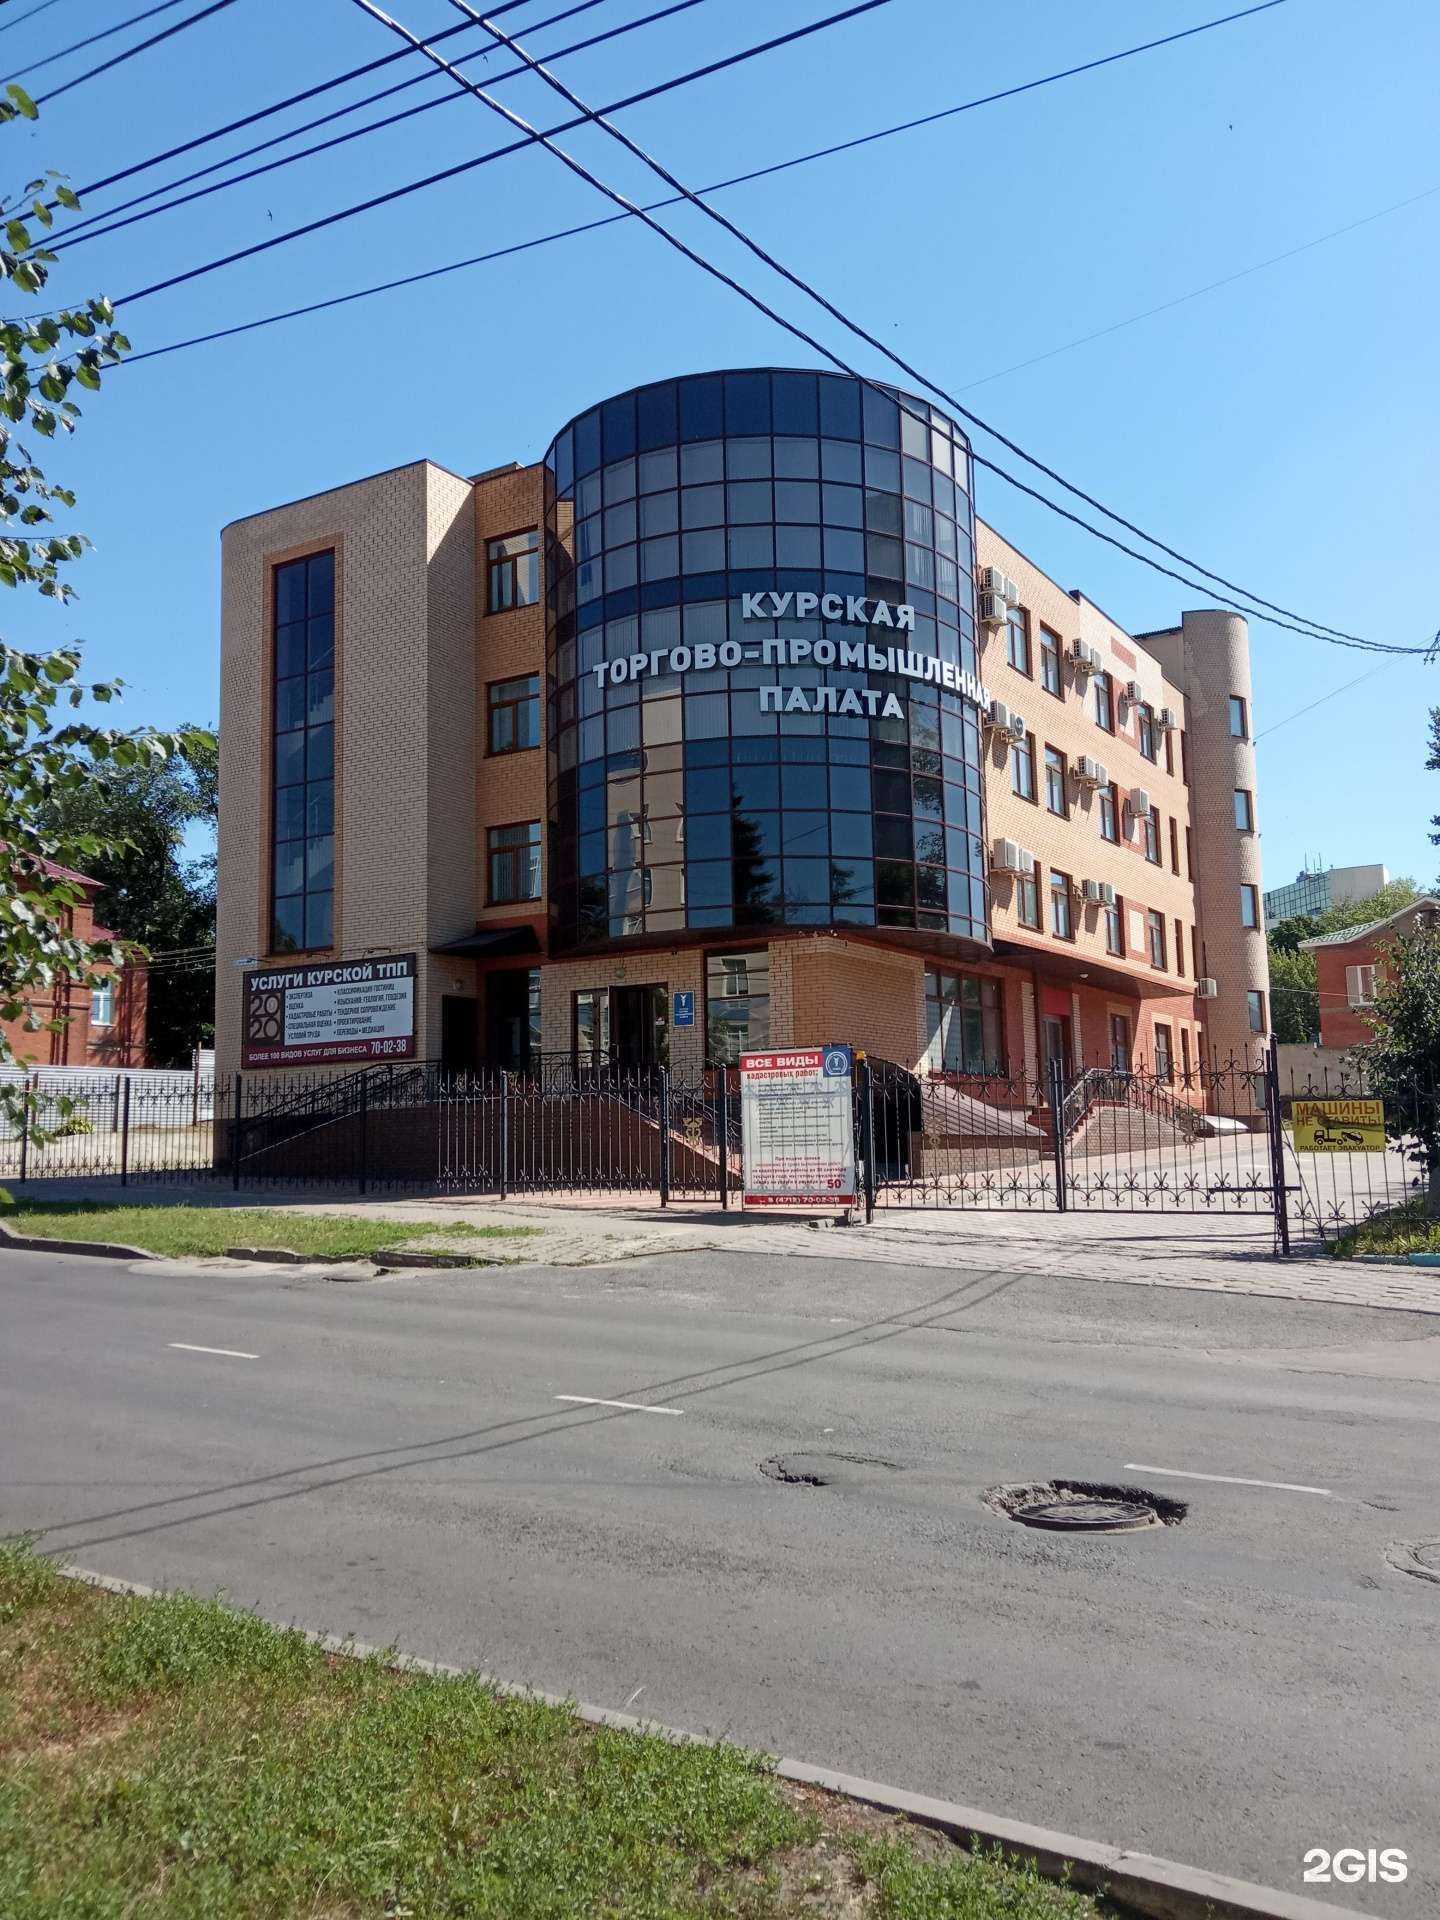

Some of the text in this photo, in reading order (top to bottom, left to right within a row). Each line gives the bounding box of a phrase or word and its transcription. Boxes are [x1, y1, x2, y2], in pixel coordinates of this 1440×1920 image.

[742, 591, 916, 632] КУРСКАЯ
[592, 639, 991, 713] ТОРГОВО-ПРОМЫШЛЕННАЯ
[759, 685, 905, 720] ПАЛАТА
[251, 961, 408, 991] УСЛУГИ КУРСКОЙ ТПП
[288, 991, 313, 1000] ЭКСПЕРТИЗА
[249, 1053, 269, 1061] БОЛЕЕ
[281, 1051, 302, 1060] ВИДОВ
[303, 1049, 322, 1057] УСЛУГ
[337, 1046, 367, 1055] БИЗНЕСА
[370, 1039, 407, 1054] 70-02-38
[746, 1055, 819, 1069] ВСЕ ВИДЫ
[747, 1071, 793, 1080] кадастровых
[1296, 1102, 1380, 1116] МАШИНЫ
[1297, 1115, 1313, 1126] НЕ
